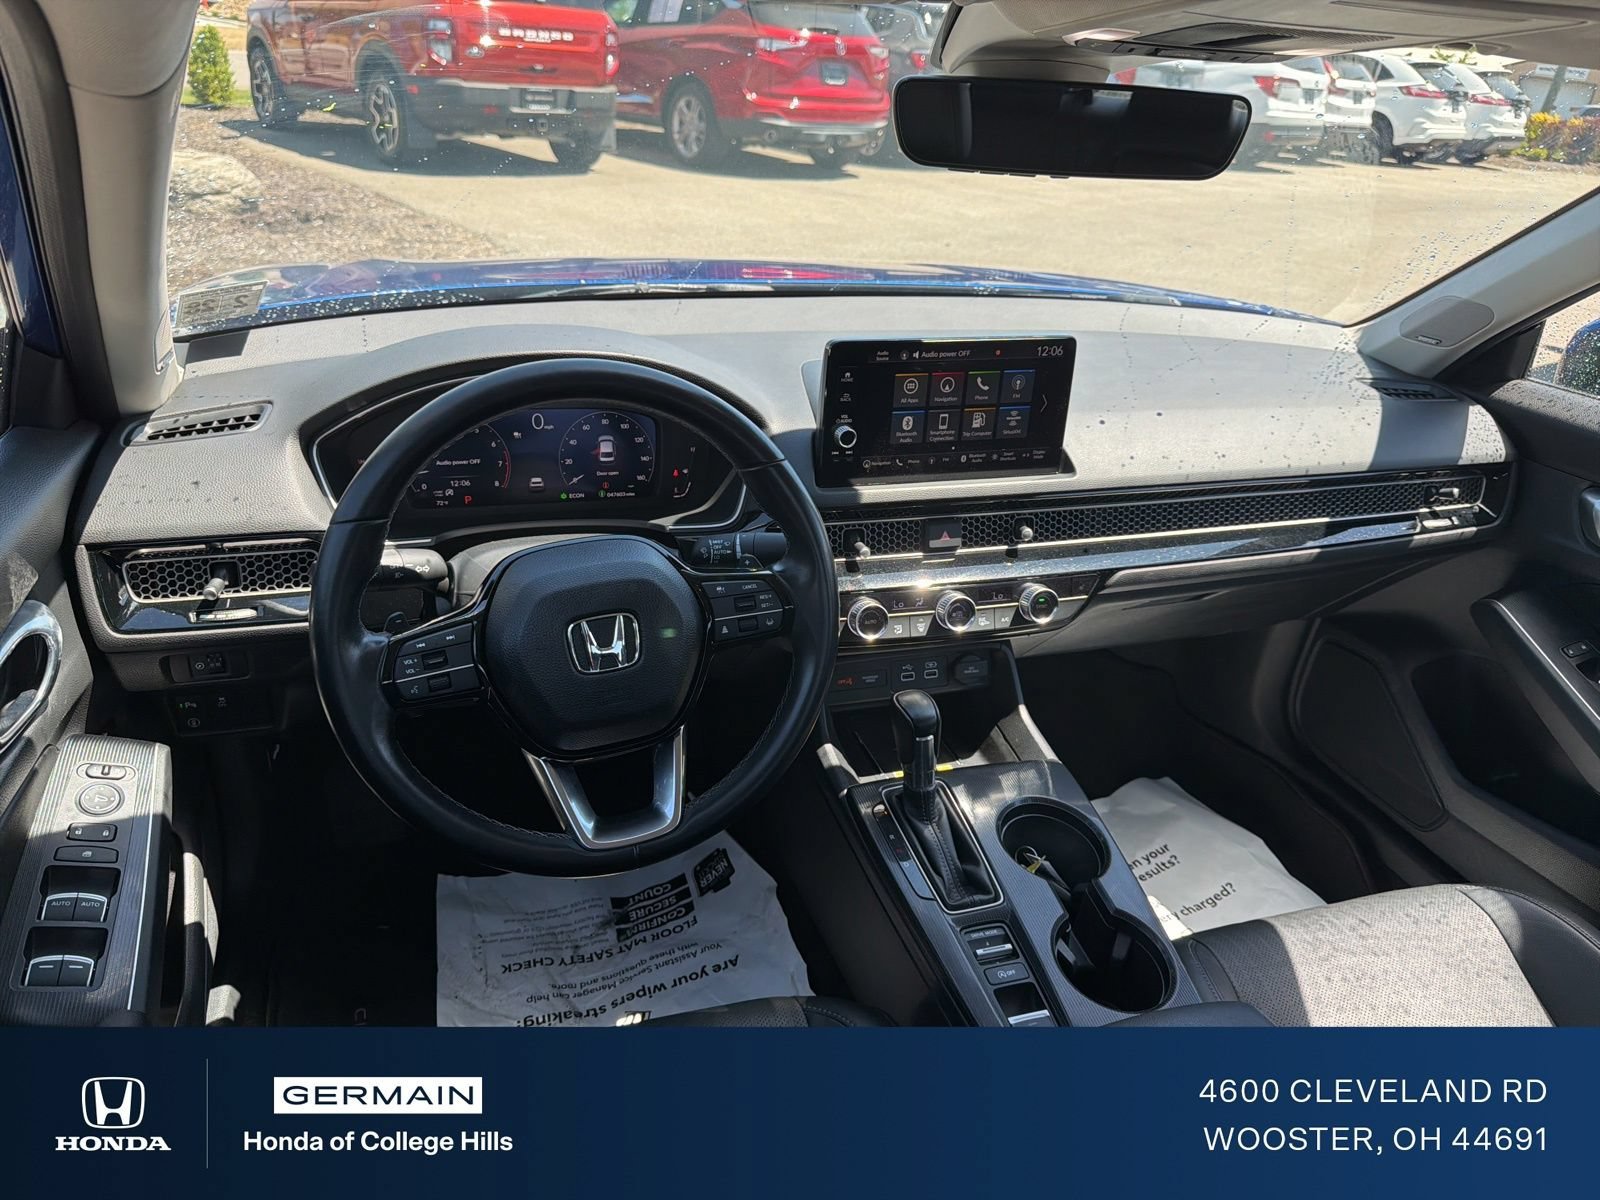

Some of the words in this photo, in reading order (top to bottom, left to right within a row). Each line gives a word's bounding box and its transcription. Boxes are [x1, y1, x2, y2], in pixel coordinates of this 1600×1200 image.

[921, 350, 936, 358] Audio
[937, 351, 957, 360] power
[958, 350, 970, 358] OFF
[1036, 346, 1064, 356] 12:06
[531, 412, 544, 430] 0
[464, 496, 472, 504] P
[894, 600, 904, 608] Lo
[992, 592, 1004, 600] Lo
[1142, 843, 1172, 865] your
[700, 858, 728, 887] NEVER
[628, 883, 672, 905] COUNT
[1180, 882, 1236, 916] charged?
[628, 896, 676, 921] SECURE
[651, 916, 698, 941] FLOOR
[617, 936, 646, 952] MAT
[677, 942, 698, 952] with
[700, 942, 721, 954] Your
[559, 949, 613, 967] SAFETY
[649, 947, 675, 961] these
[654, 951, 698, 969] Assistant
[501, 956, 554, 975] CHECK
[601, 958, 647, 982] questions
[711, 955, 740, 975] Are
[579, 977, 598, 989] and
[619, 964, 652, 985] Service
[671, 965, 707, 988] your
[525, 992, 550, 1004] help
[552, 991, 570, 1000] can
[573, 981, 616, 1000] Manager
[610, 982, 667, 1008] wipers
